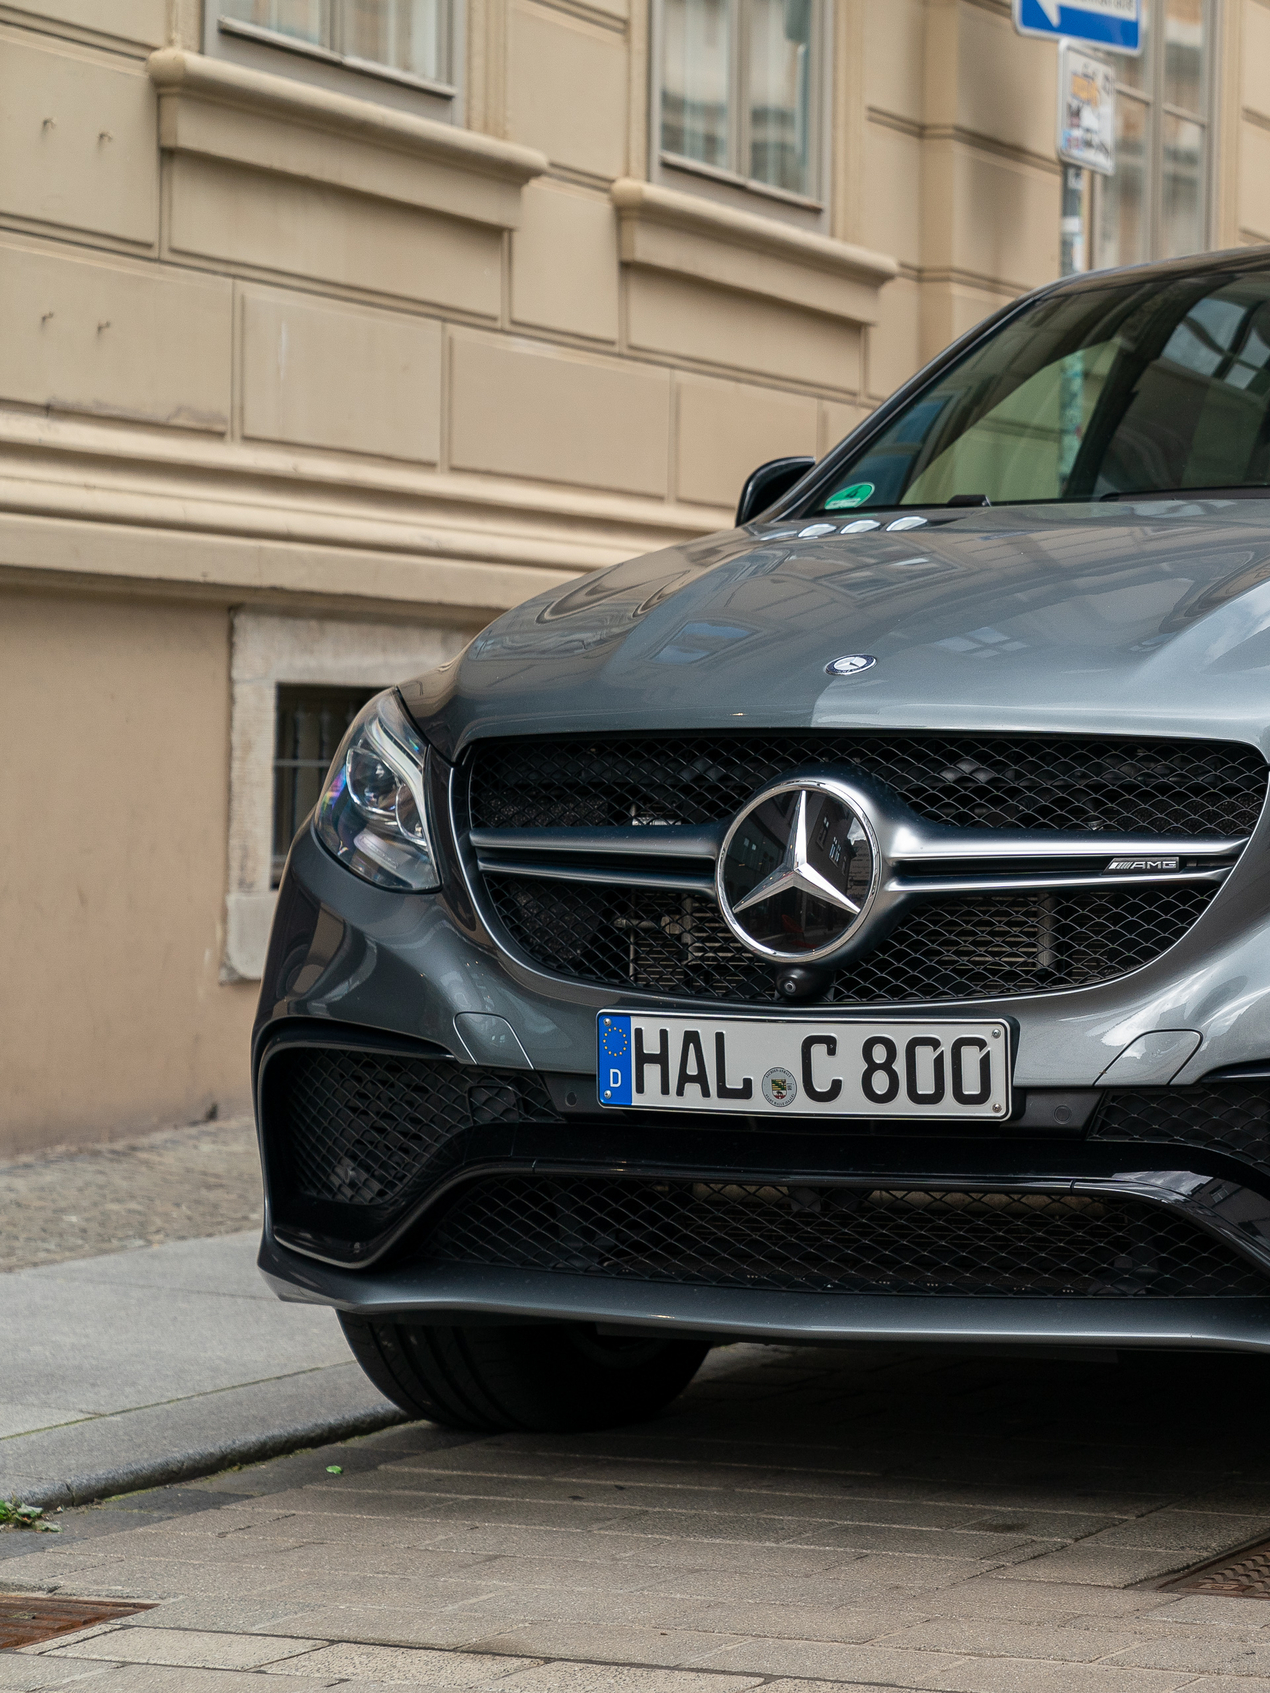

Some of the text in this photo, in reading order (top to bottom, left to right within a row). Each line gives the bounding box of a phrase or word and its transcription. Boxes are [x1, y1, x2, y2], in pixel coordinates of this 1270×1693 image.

[609, 1069, 622, 1087] D
[634, 1026, 992, 1105] HAL C 800
